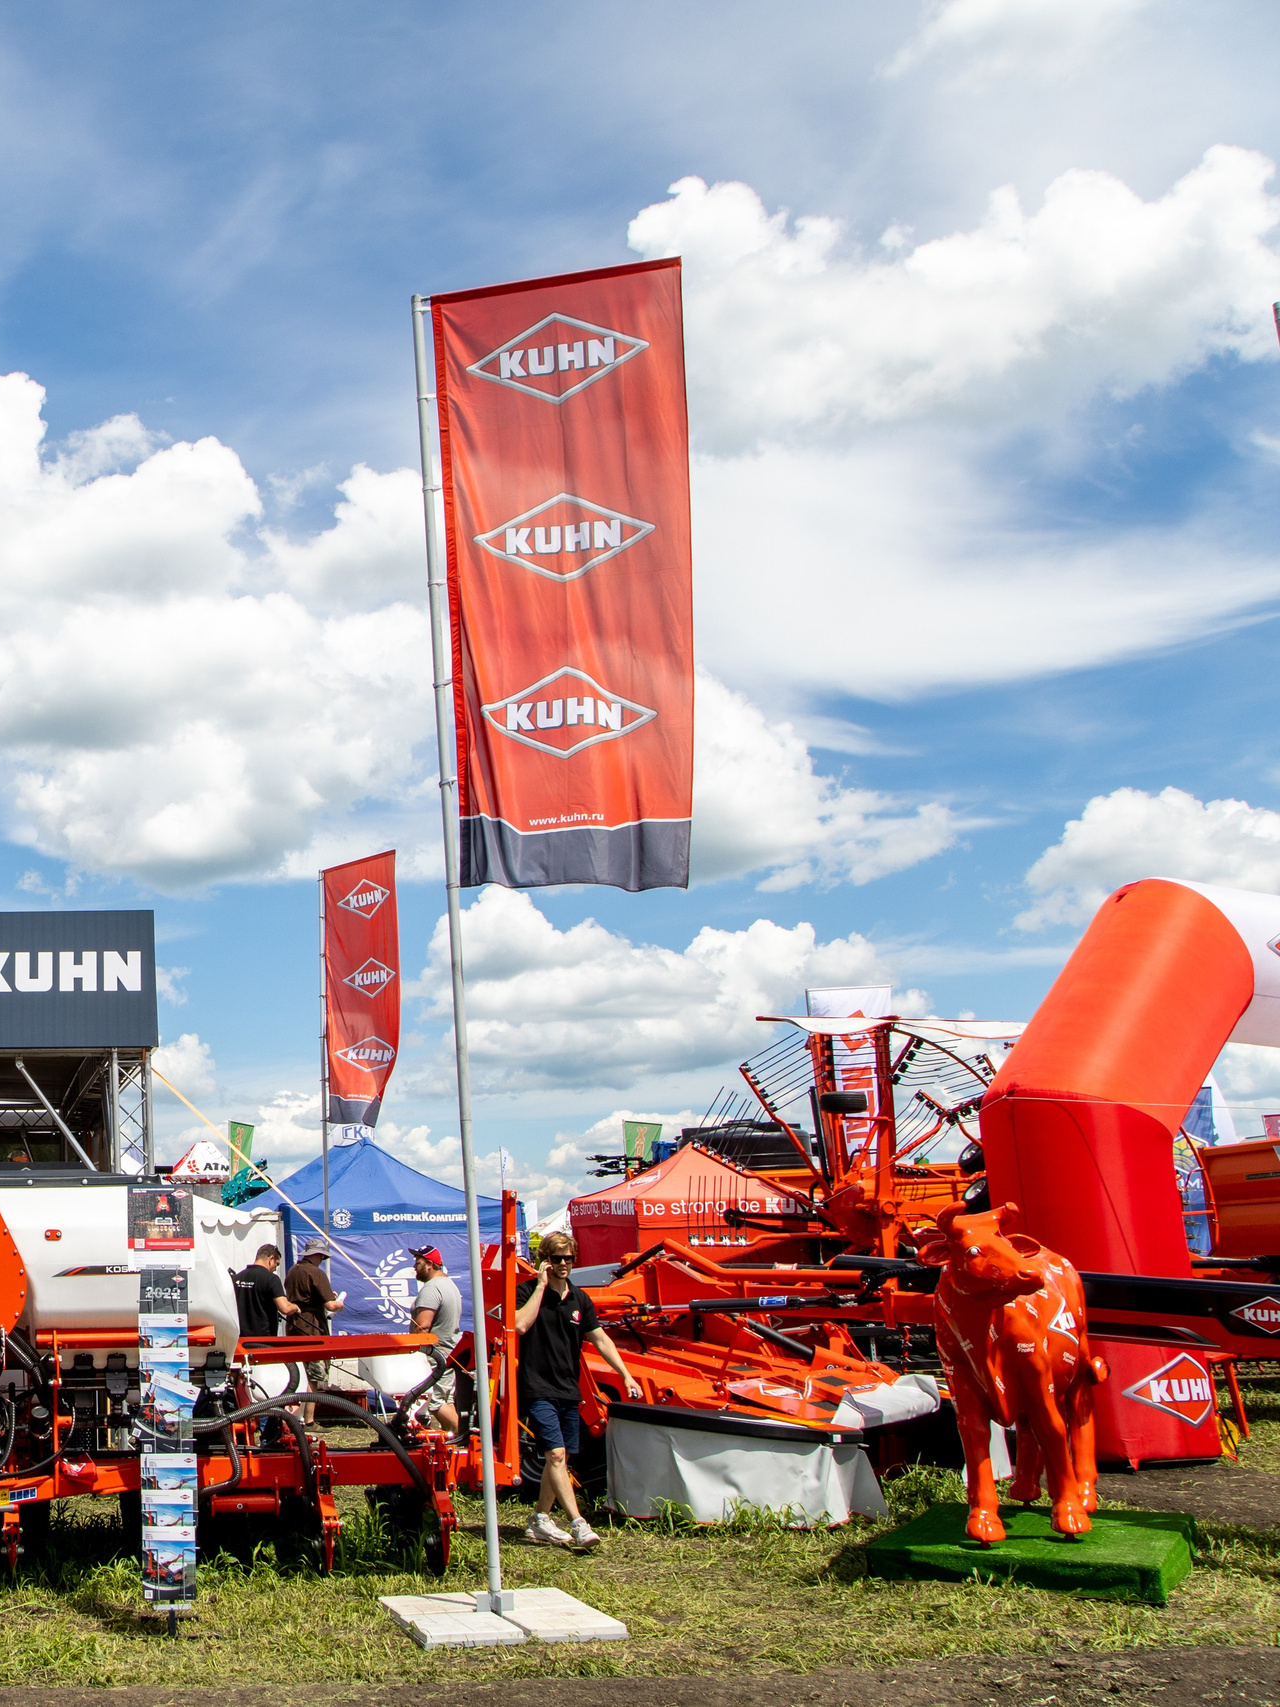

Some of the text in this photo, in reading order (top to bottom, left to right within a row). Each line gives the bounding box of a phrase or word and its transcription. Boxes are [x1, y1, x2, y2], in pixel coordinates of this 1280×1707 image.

[498, 334, 615, 381] KUHN
[504, 518, 621, 556] KUHN
[505, 695, 622, 733] KUHN
[529, 812, 604, 827] www.kuhn.ru
[349, 888, 383, 909] KUHN
[354, 968, 388, 986] KUHN
[346, 1048, 392, 1062] KUHN
[571, 1201, 579, 1216] be
[601, 1200, 610, 1214] be
[611, 1200, 635, 1216] KUHN
[642, 1200, 666, 1216] be
[737, 1197, 760, 1212] be
[765, 1197, 806, 1214] KU
[1058, 1311, 1077, 1331] KU
[1244, 1308, 1280, 1322] KUH
[1149, 1378, 1212, 1403] KUHN
